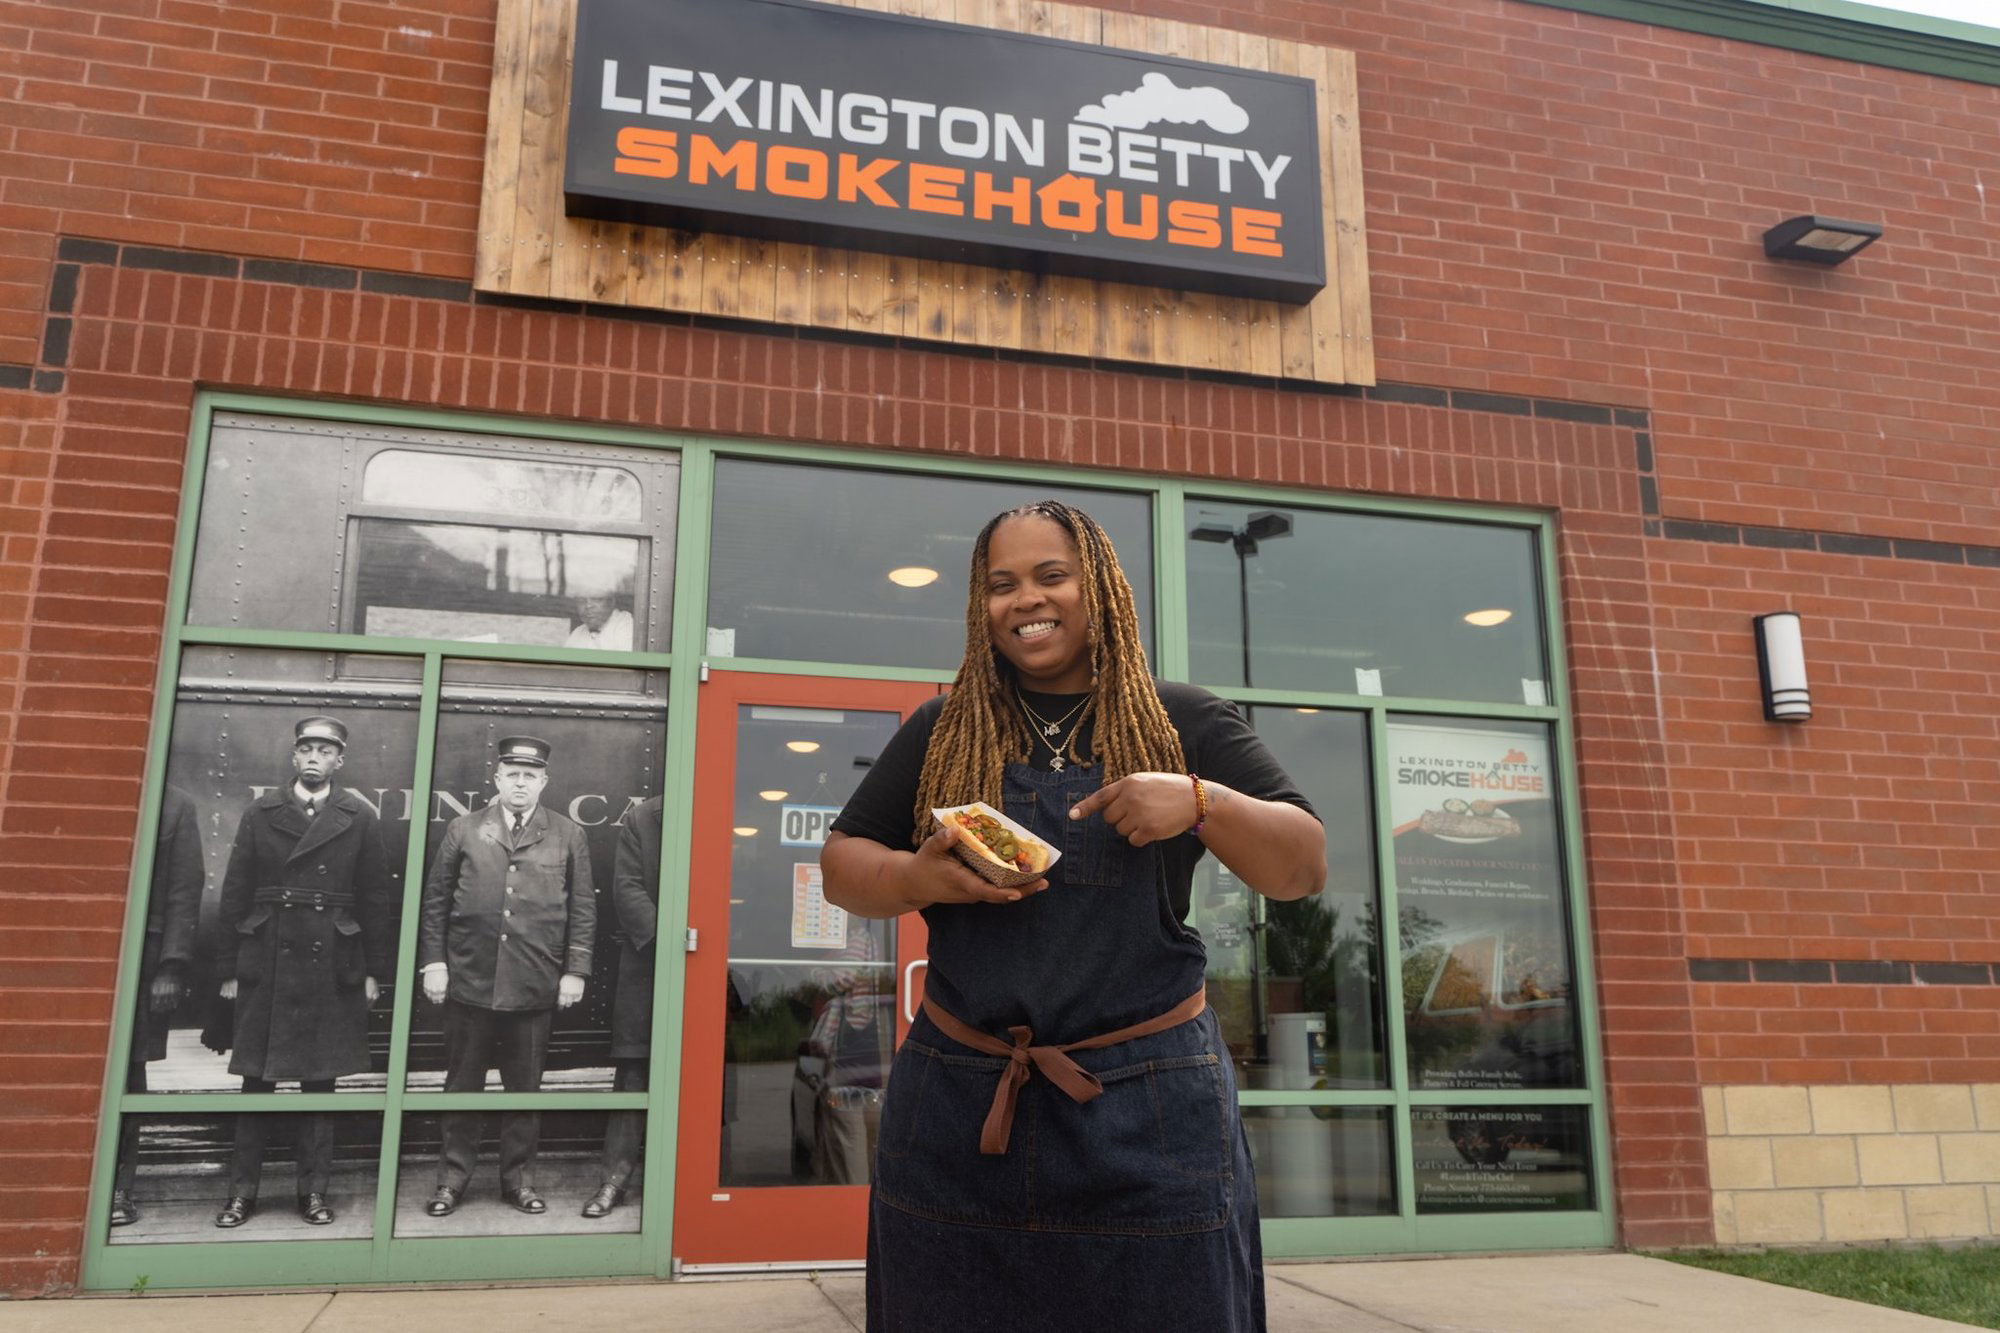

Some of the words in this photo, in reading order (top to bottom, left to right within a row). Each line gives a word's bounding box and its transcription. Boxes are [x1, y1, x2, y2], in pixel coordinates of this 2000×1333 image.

[601, 59, 1044, 167] LEXINGTON
[1067, 121, 1292, 200] BETTY
[614, 126, 1283, 257] SMOKEHOUSE
[1399, 756, 1487, 769] LEXINGTON
[1493, 763, 1539, 772] BETTY
[1398, 768, 1543, 792] SMOKEHOUSE
[785, 810, 839, 842] OPE
[1436, 1112, 1469, 1121] CREATE
[1470, 1112, 1477, 1121] A
[1478, 1112, 1504, 1121] MENU
[1505, 1113, 1523, 1122] FOR
[1524, 1113, 1543, 1122] YOU
